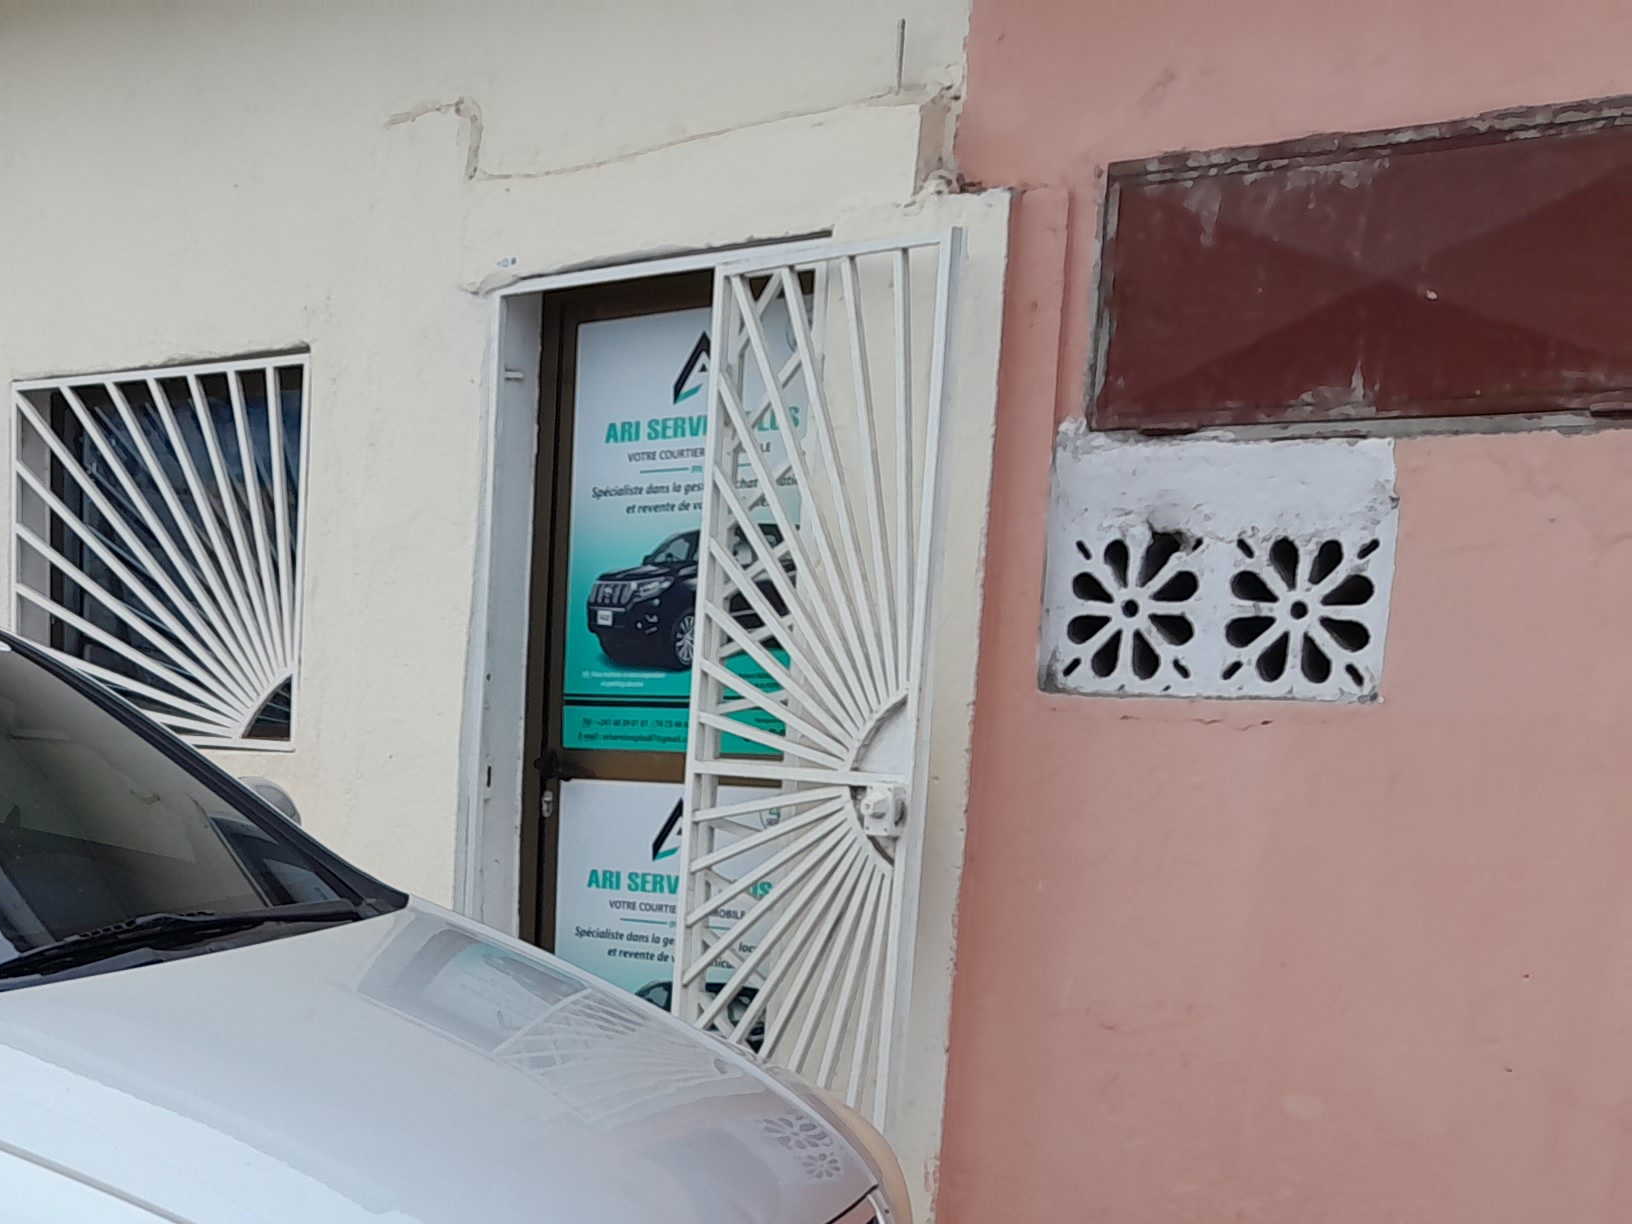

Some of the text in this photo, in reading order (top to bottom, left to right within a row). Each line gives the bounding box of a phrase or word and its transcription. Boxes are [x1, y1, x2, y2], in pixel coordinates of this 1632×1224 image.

[605, 420, 640, 443] ARI
[647, 415, 707, 441] SERVI
[627, 447, 705, 462] VOTRE COURTIER
[591, 483, 643, 500] Spécialiste
[645, 482, 670, 495] dans
[672, 481, 681, 493] la
[626, 503, 636, 514] et
[638, 502, 676, 514] revente
[677, 499, 690, 511] de
[587, 869, 679, 895] ARI SERV
[609, 900, 637, 911] VOTRE
[638, 901, 677, 914] COURTIE
[574, 926, 624, 940] Spécialiste
[626, 930, 649, 943] dans
[651, 932, 660, 944] la
[607, 948, 617, 957] et
[618, 949, 655, 960] revente
[657, 950, 669, 962] de
